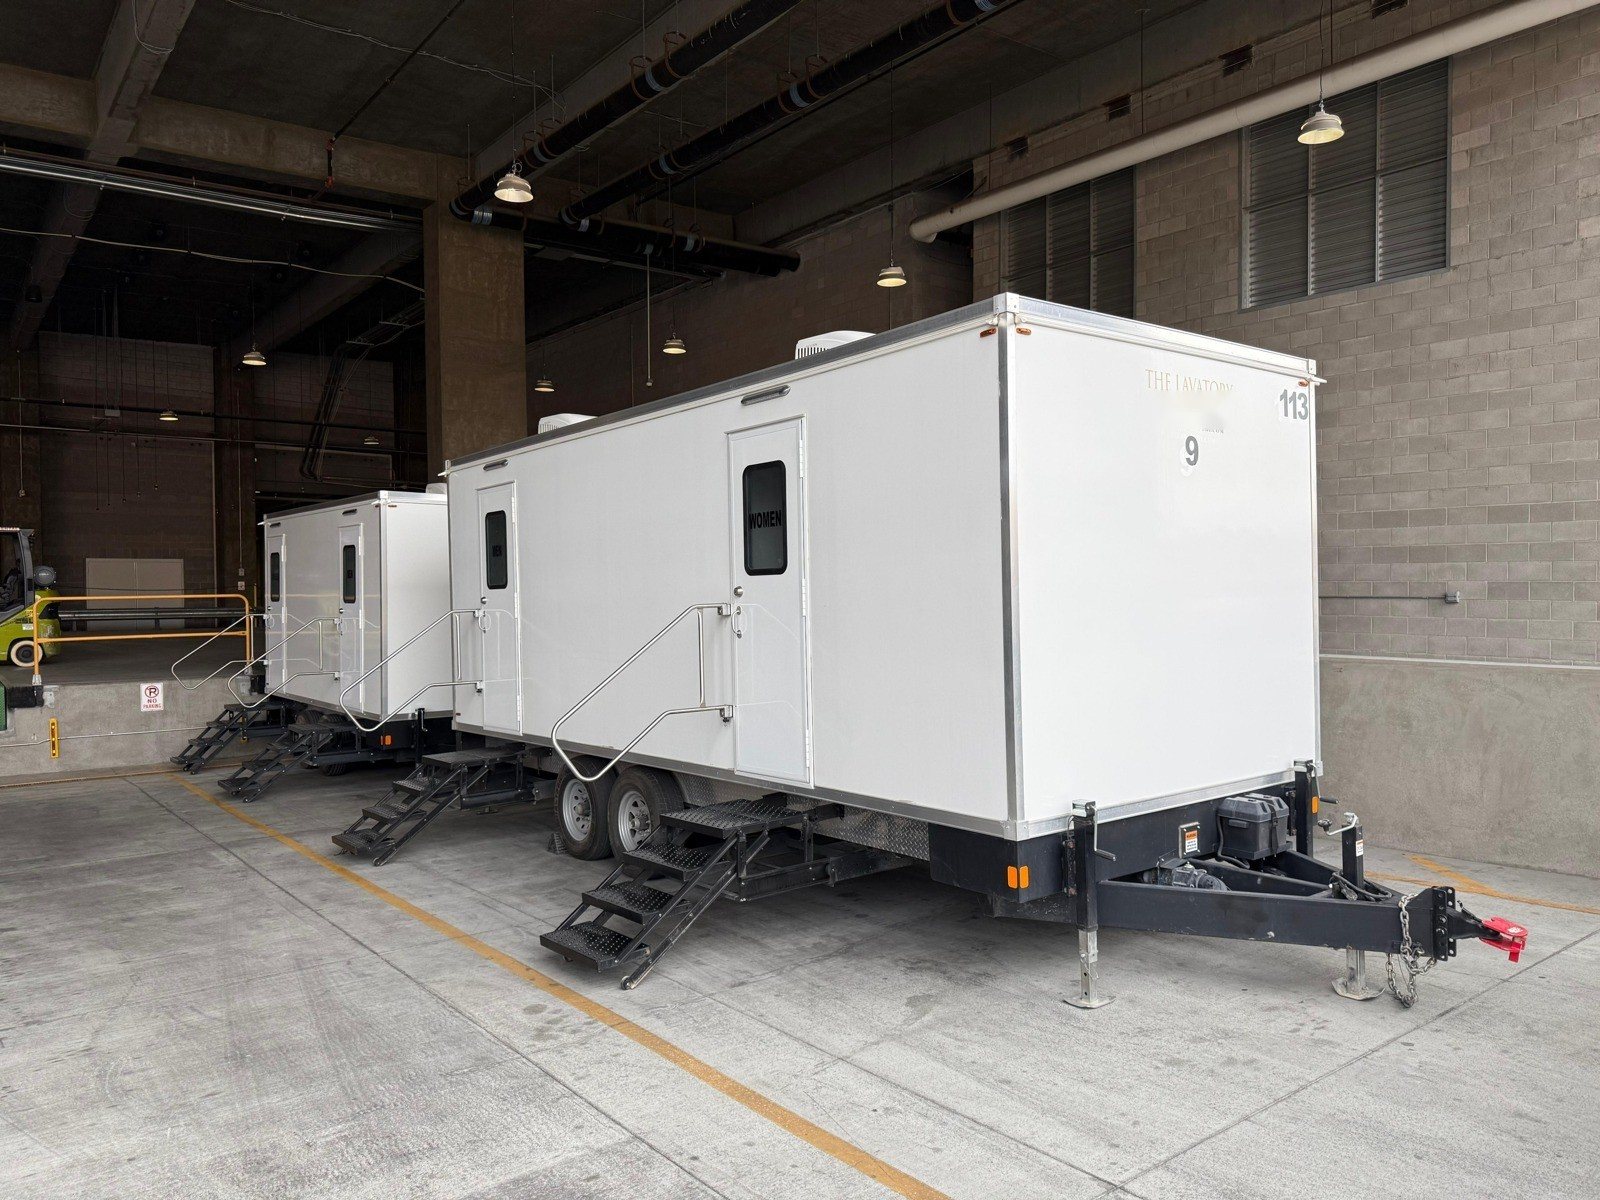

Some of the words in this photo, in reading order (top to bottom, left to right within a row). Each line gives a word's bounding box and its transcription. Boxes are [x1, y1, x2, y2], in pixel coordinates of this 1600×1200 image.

[1145, 369, 1171, 391] THE
[1279, 389, 1308, 420] 113
[1185, 435, 1199, 466] 9
[749, 509, 782, 529] WOMEN
